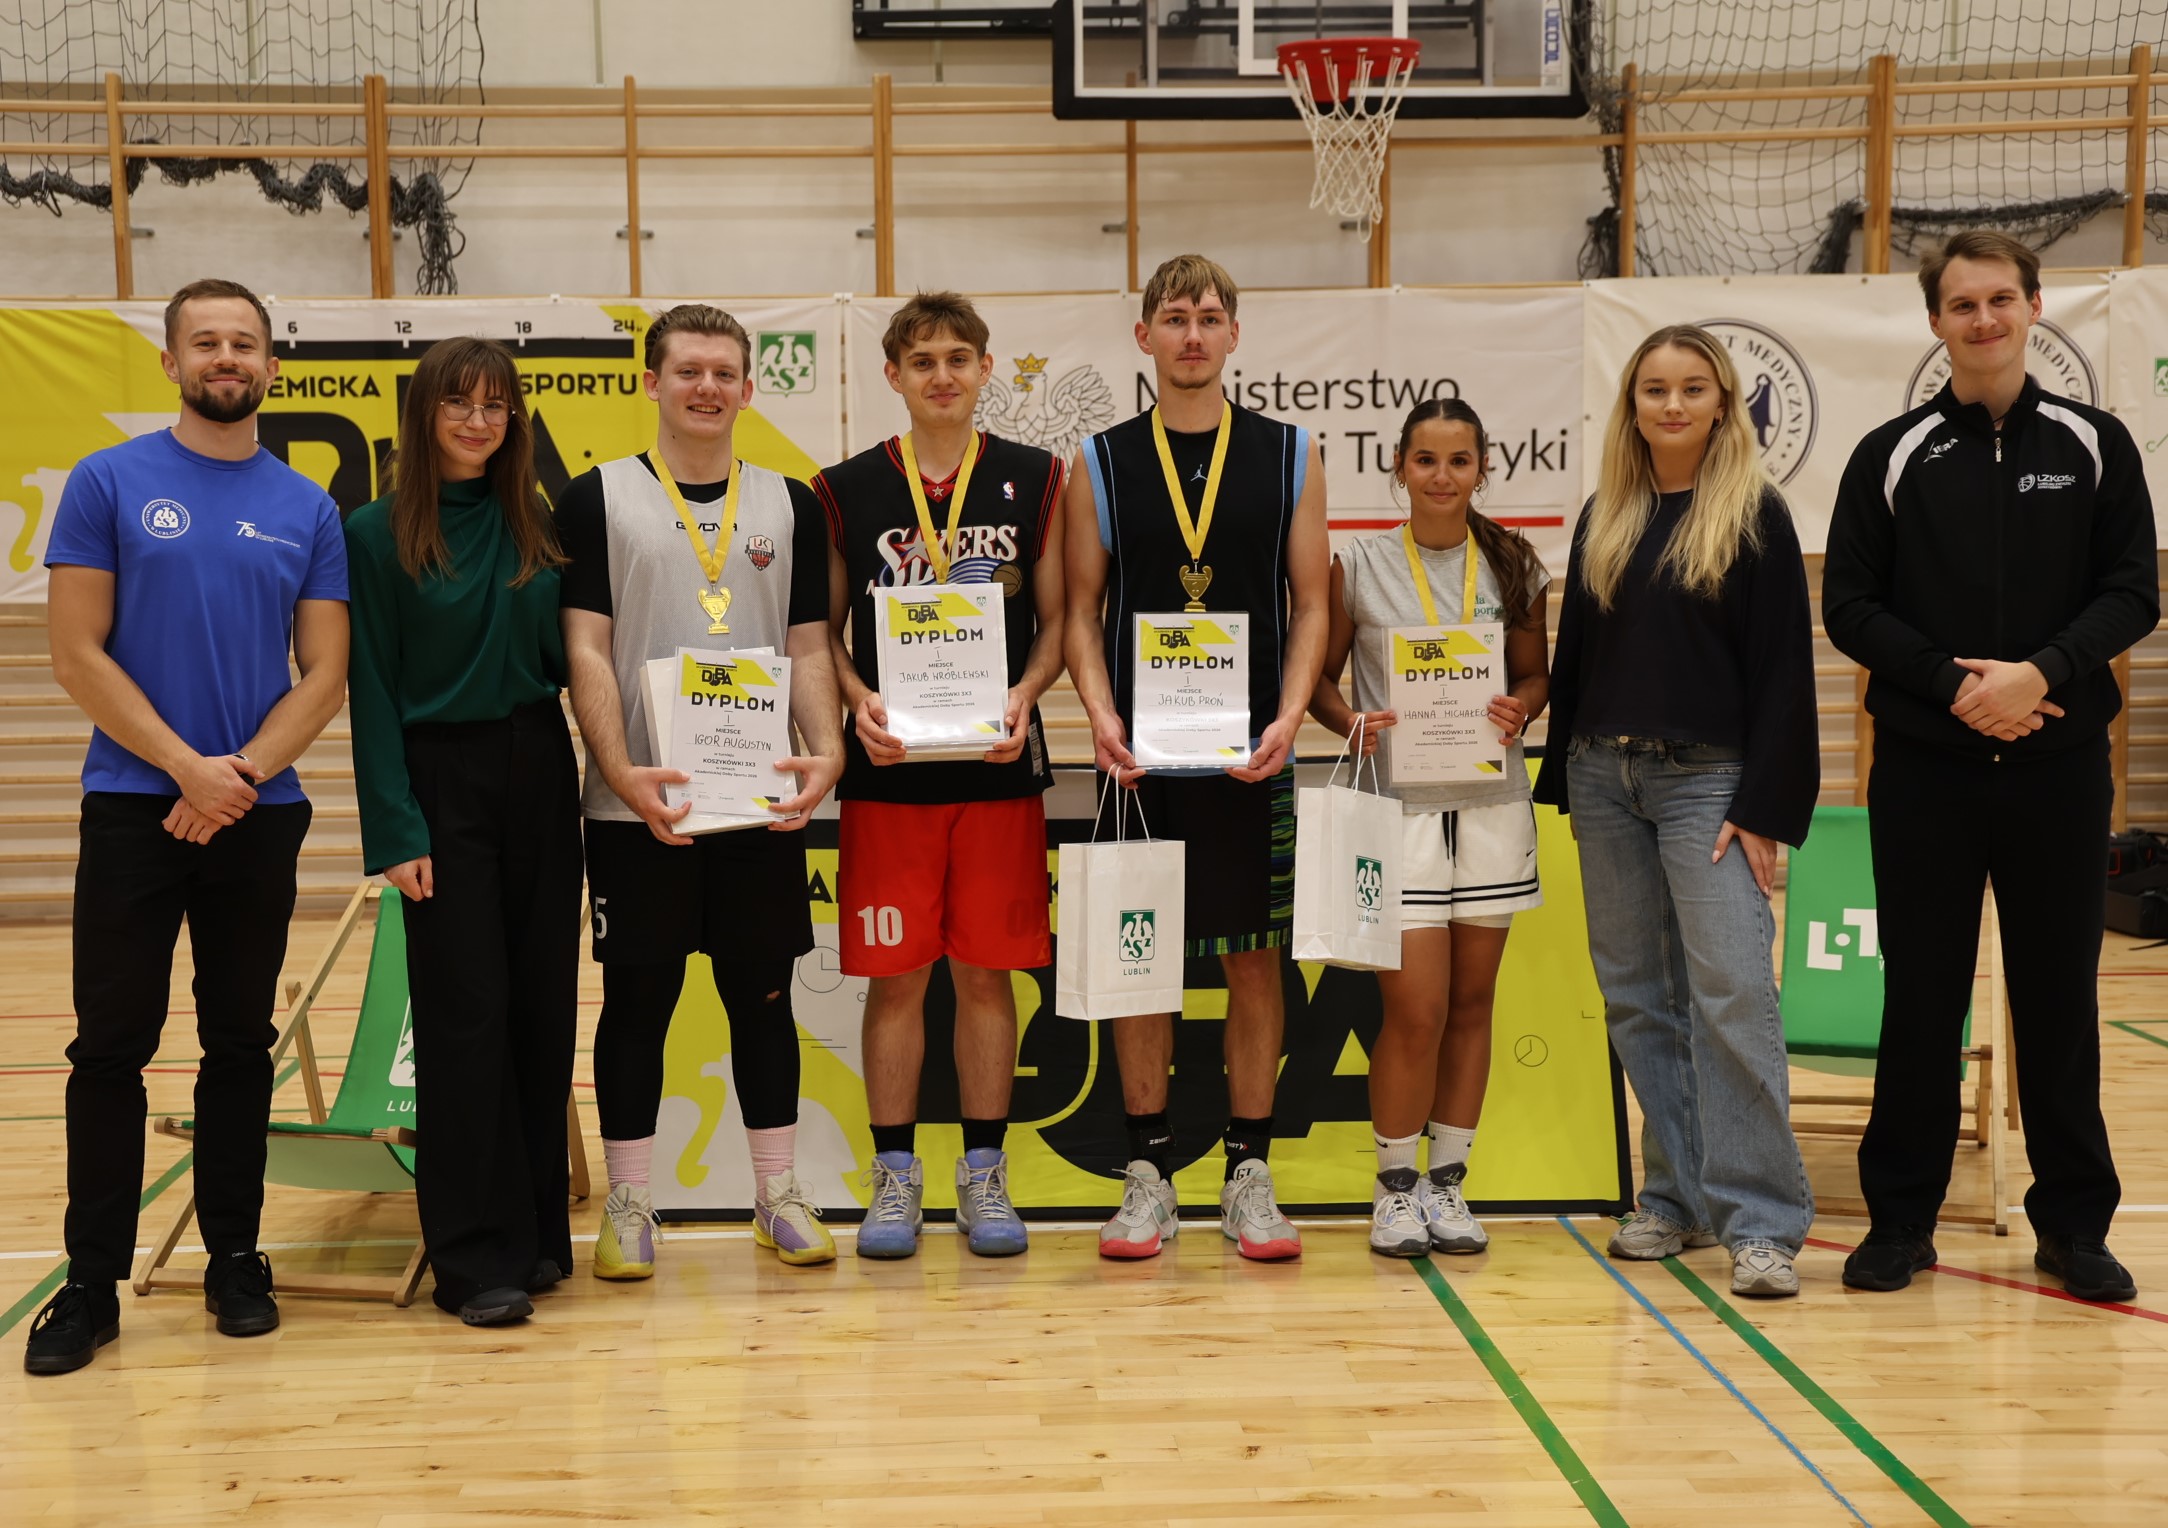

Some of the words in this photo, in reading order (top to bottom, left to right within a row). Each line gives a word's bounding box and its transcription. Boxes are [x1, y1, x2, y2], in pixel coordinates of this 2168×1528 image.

[288, 321, 298, 334] 6
[394, 321, 412, 334] 12
[514, 321, 532, 334] 18
[2028, 334, 2083, 400] MEDYCZ
[519, 372, 637, 395] SPORTU
[1345, 428, 1568, 481] Tutyki
[235, 520, 256, 538] 75
[900, 628, 984, 645] DYPLOM
[1151, 656, 1234, 669] DYPLOM
[899, 672, 929, 683] JAKUB
[1405, 666, 1490, 682] DYPLOM
[691, 692, 774, 712] DYPLOM
[1158, 694, 1196, 706] JAKUB
[1404, 710, 1436, 719] HANNA
[1444, 708, 1488, 718] MICHAŁEC
[694, 733, 720, 747] IGOR
[723, 737, 771, 751] AUGUSTYN
[703, 758, 743, 766] KOSZYKÓWKI
[857, 906, 904, 946] 10
[1358, 914, 1379, 924] LUBLIN
[1123, 967, 1151, 976] LUBLIN
